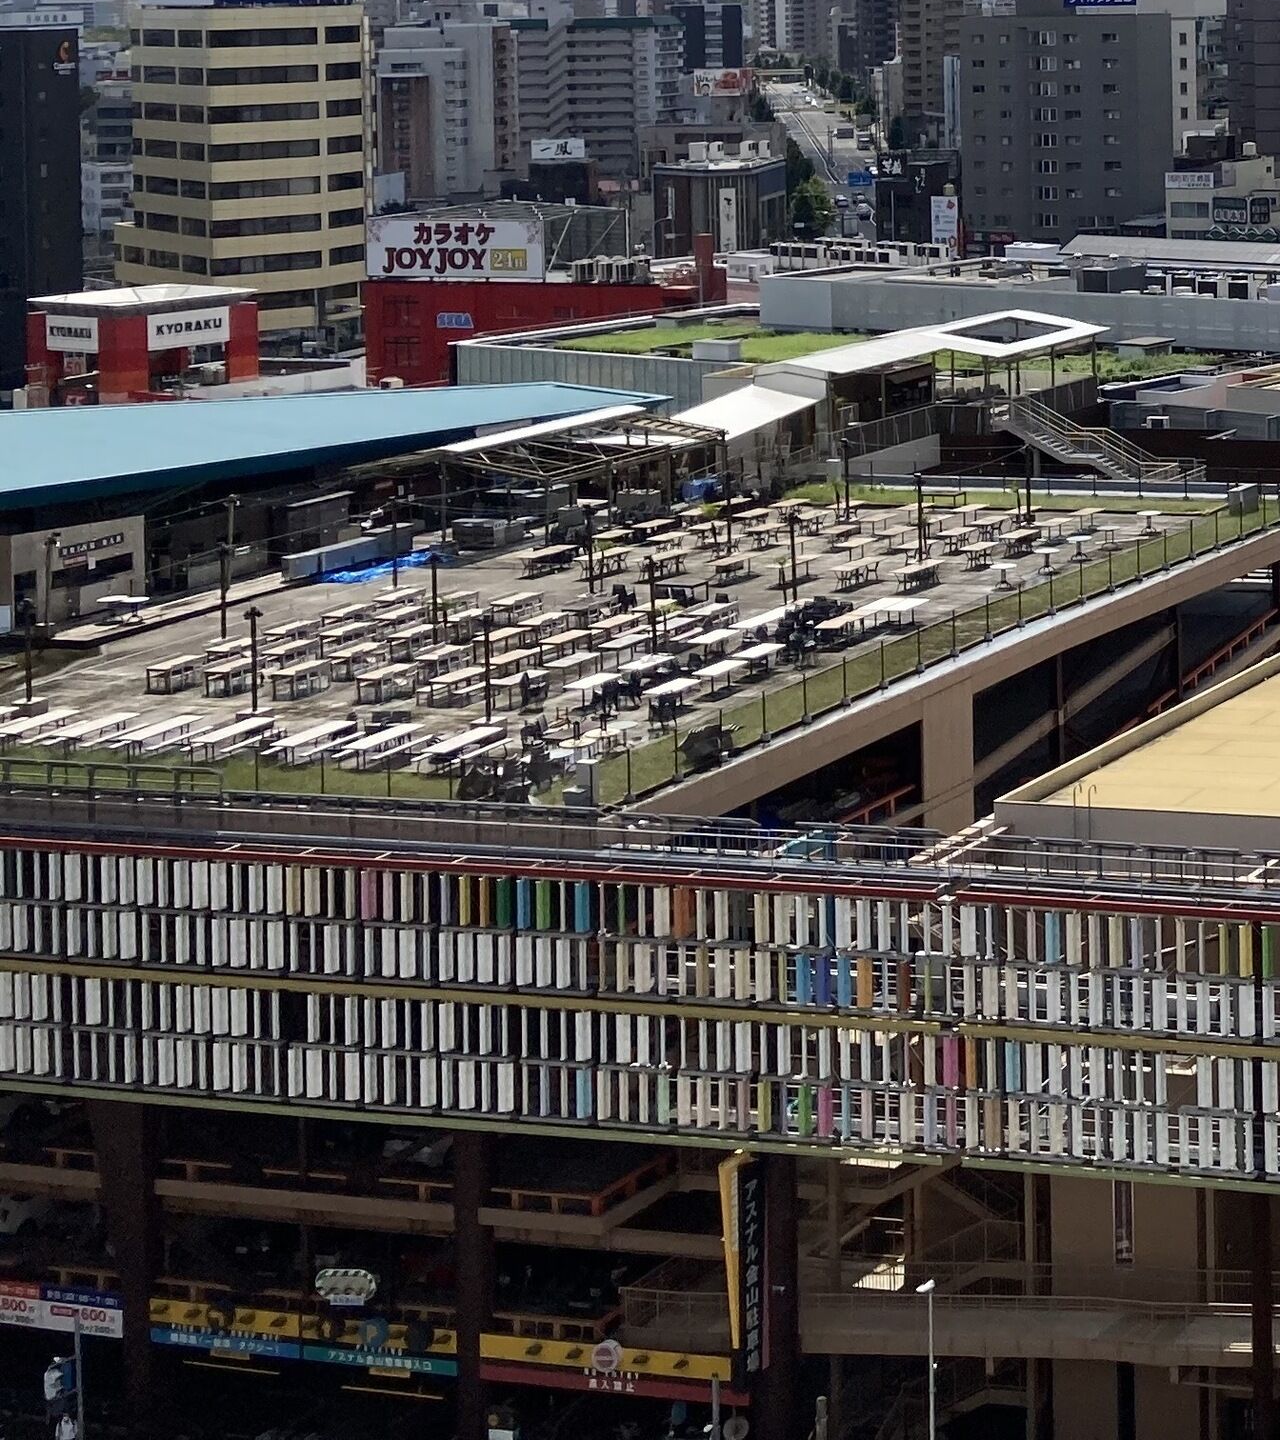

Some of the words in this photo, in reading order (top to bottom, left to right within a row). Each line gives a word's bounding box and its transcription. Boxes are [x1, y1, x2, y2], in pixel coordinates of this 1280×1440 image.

[414, 222, 495, 245] カラオケ
[383, 247, 487, 274] JOYJOY
[156, 317, 222, 336] KYORAKU
[437, 311, 474, 328] SEGA
[49, 326, 92, 339] KYORAKU
[102, 535, 122, 546] BAR
[744, 1178, 760, 1373] アスナル金山駐車場
